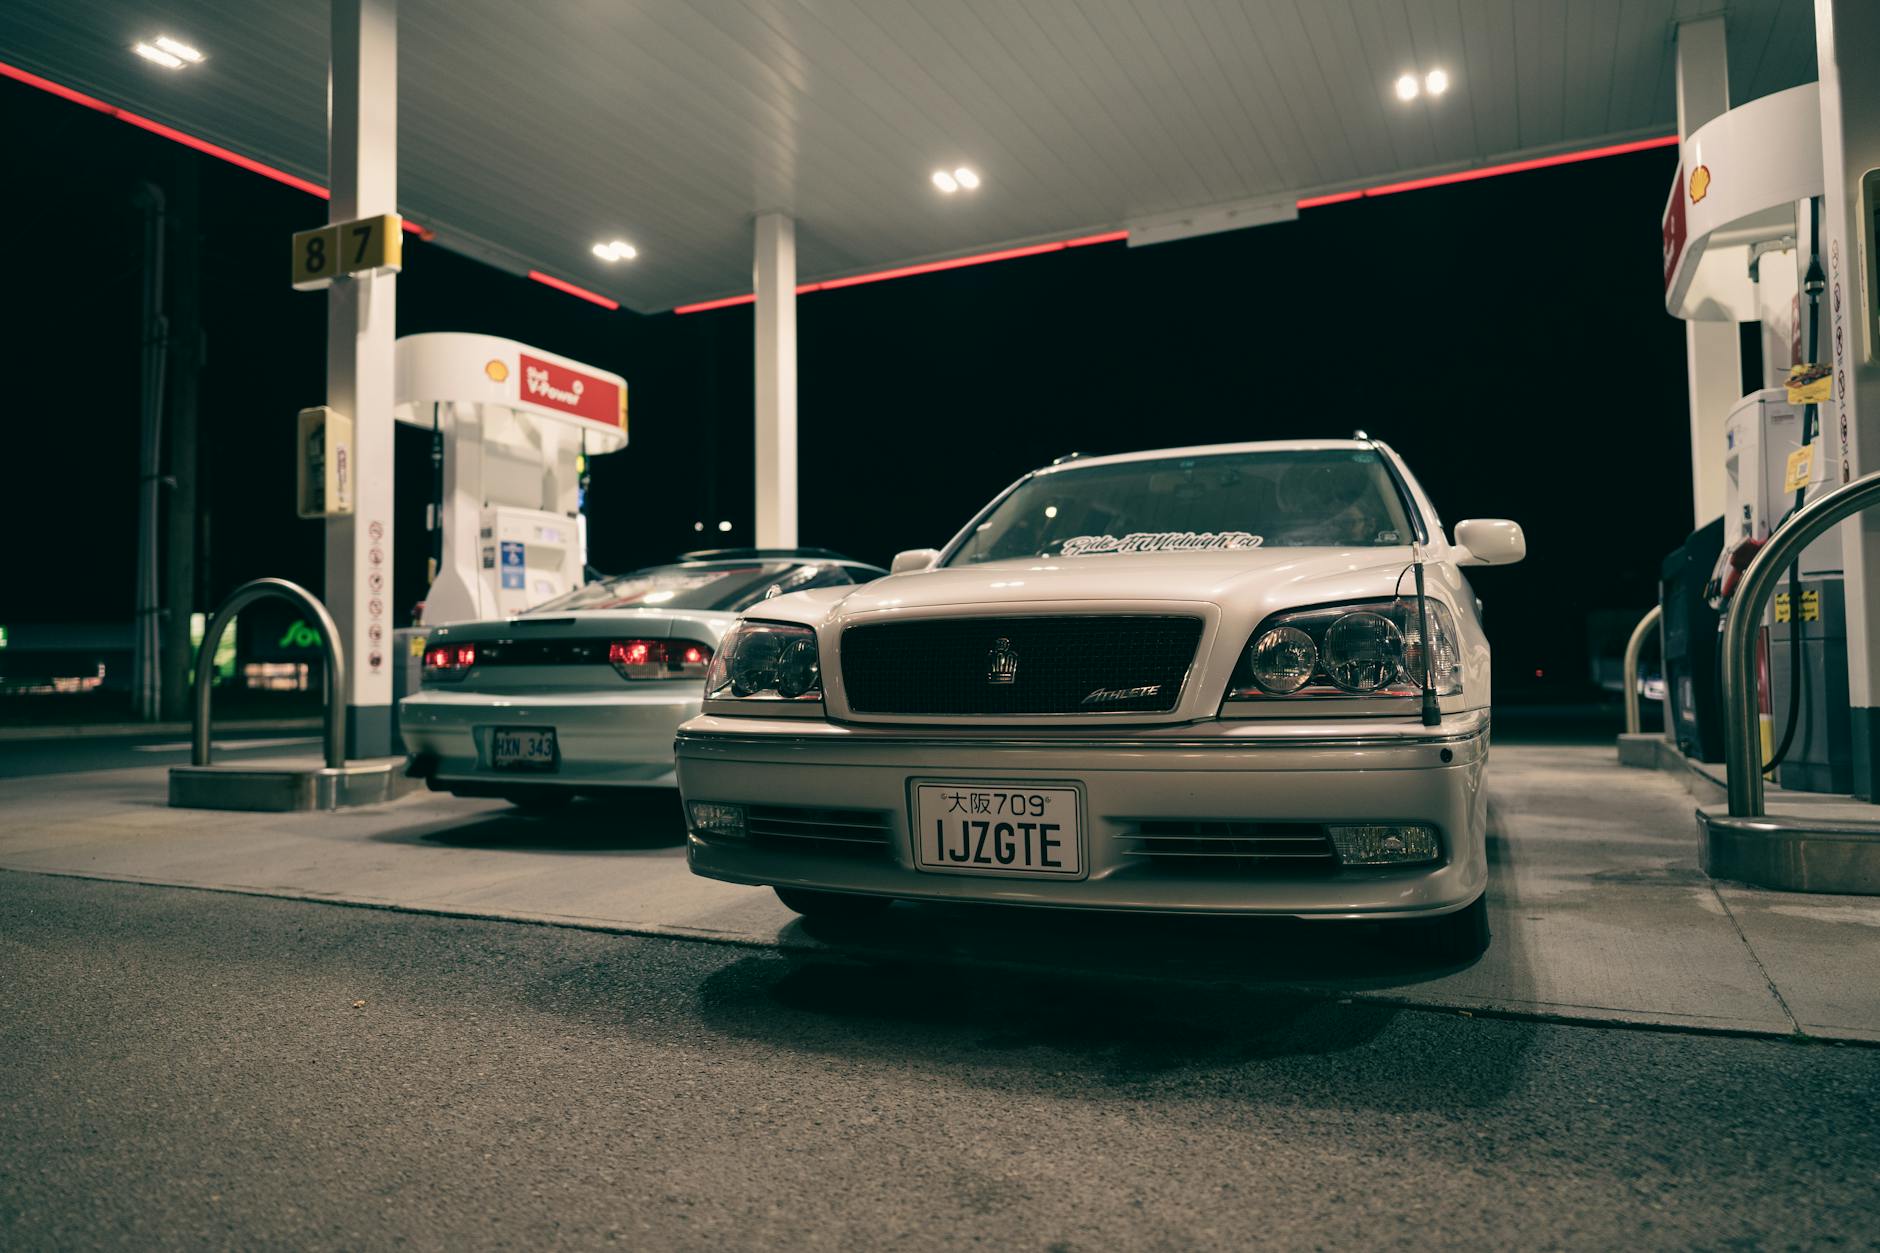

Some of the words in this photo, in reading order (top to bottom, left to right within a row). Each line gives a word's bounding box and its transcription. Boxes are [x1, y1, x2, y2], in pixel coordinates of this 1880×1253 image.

[306, 237, 325, 273] 8
[353, 226, 372, 264] 7
[1081, 685, 1161, 704] ATHLETE
[527, 737, 552, 757] 343
